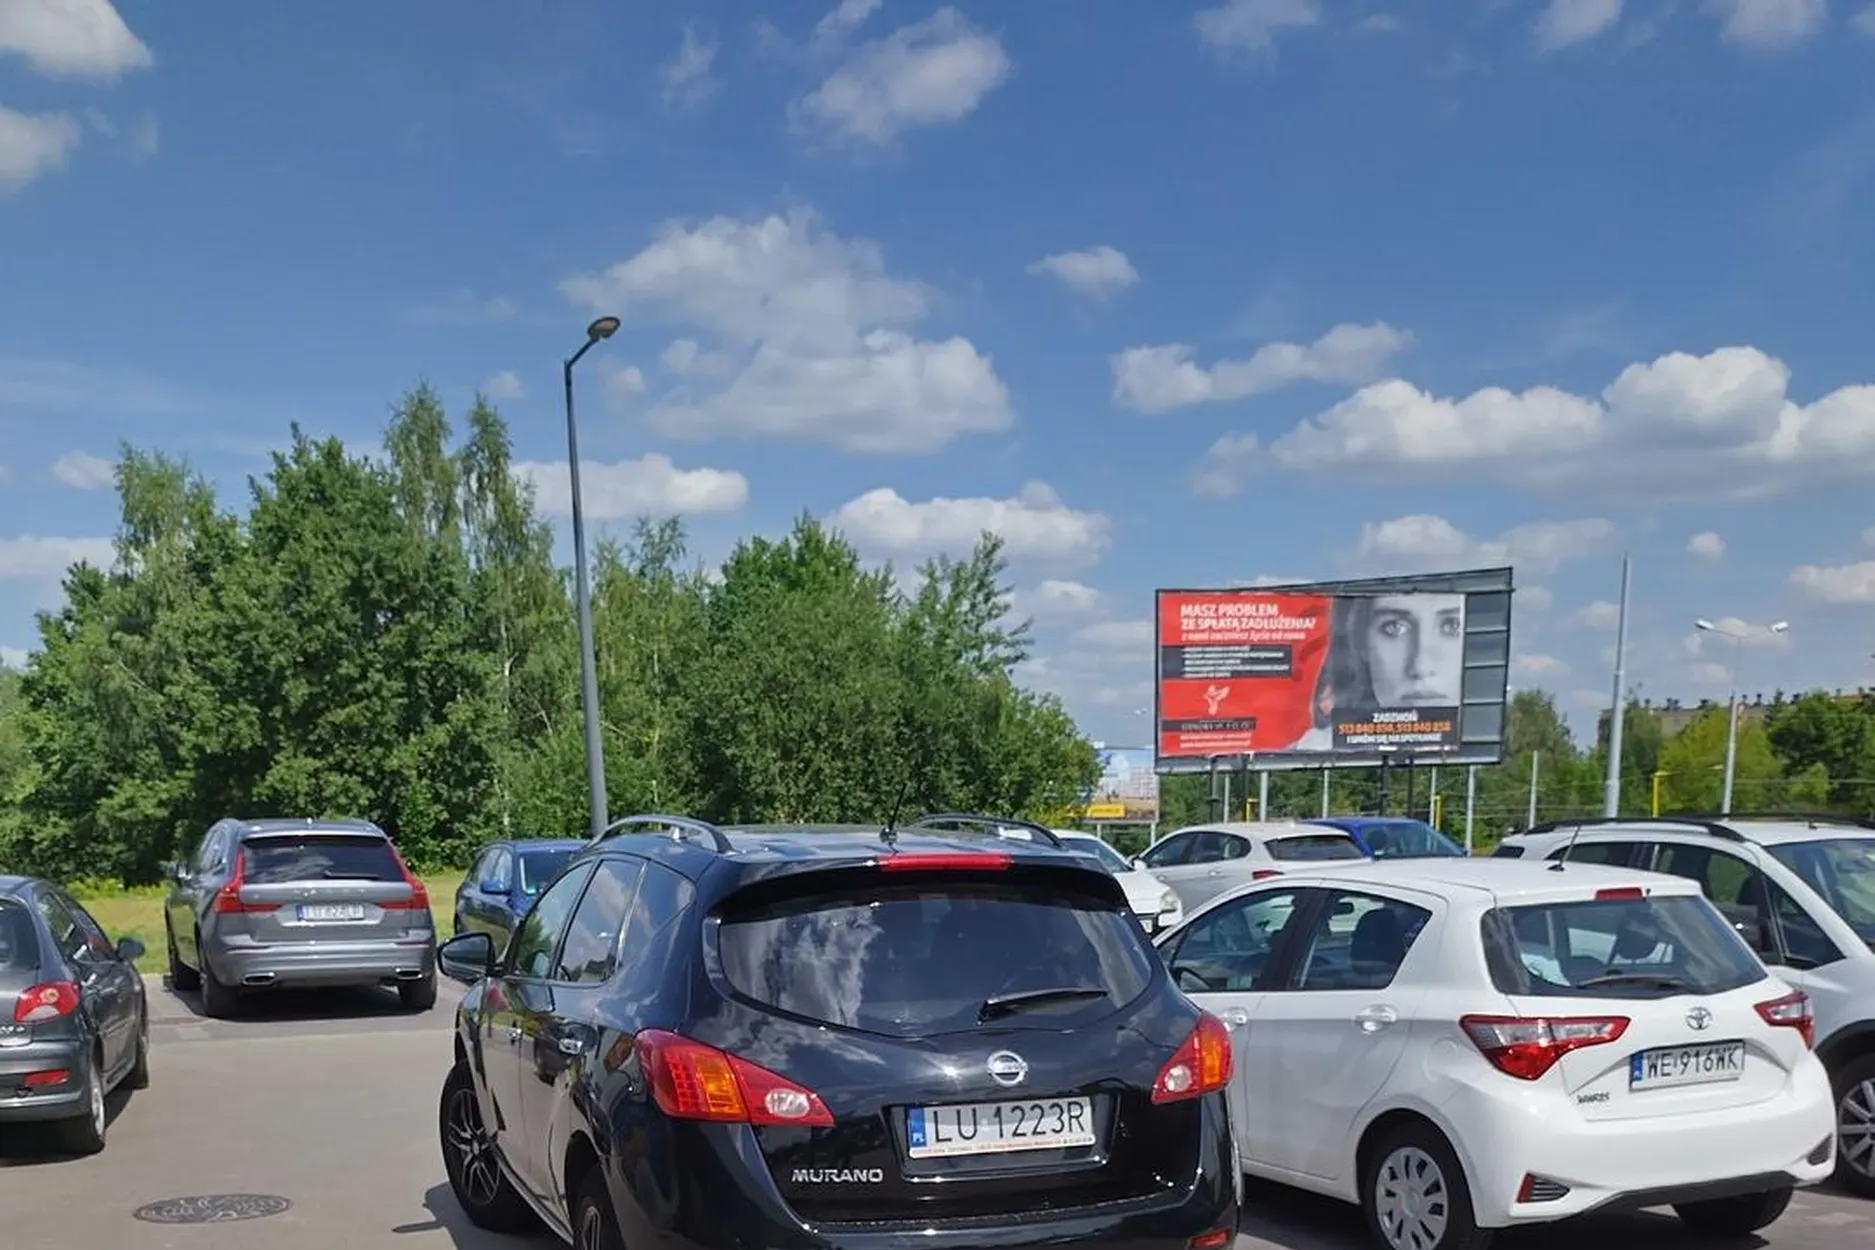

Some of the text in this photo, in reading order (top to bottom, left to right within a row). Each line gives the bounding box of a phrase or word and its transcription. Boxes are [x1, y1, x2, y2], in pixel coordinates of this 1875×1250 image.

[1180, 603, 1279, 617] MASZ PROBLEM
[1181, 618, 1197, 630] ZE
[1646, 1052, 1673, 1078] WE
[933, 1100, 1085, 1143] LU 1223R
[792, 1168, 884, 1183] MURANO
